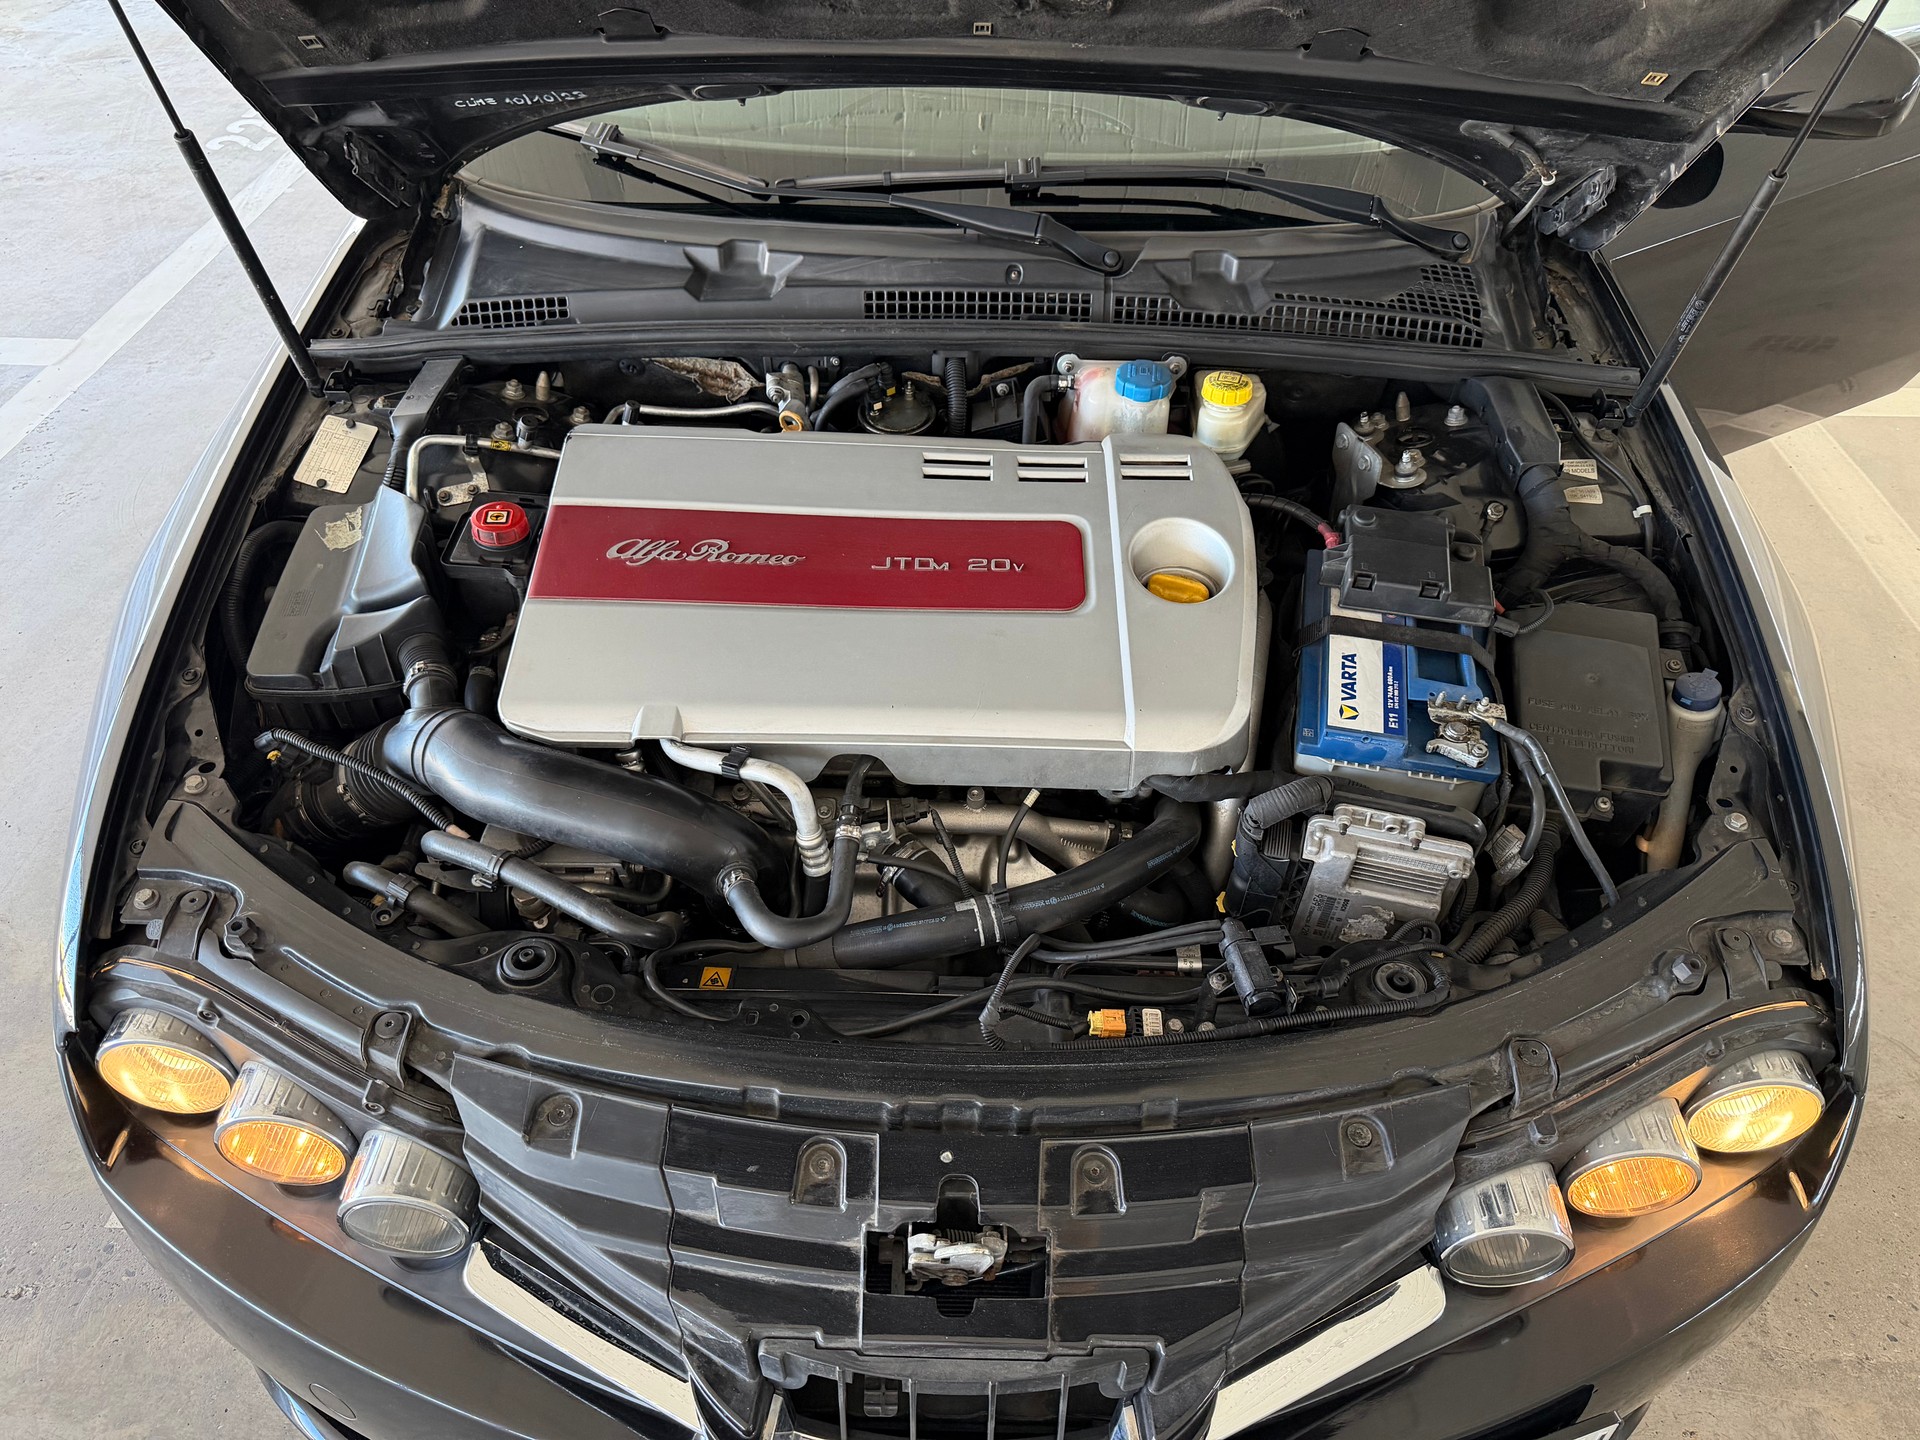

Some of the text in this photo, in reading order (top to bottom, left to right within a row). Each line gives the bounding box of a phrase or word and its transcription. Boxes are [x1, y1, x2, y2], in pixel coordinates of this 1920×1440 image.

[606, 538, 806, 566] Alfa Romeo
[1341, 653, 1357, 702] VARTA
[1528, 697, 1555, 709] FUSE
[1388, 712, 1399, 729] E11
[1529, 722, 1594, 740] CENTRALINA
